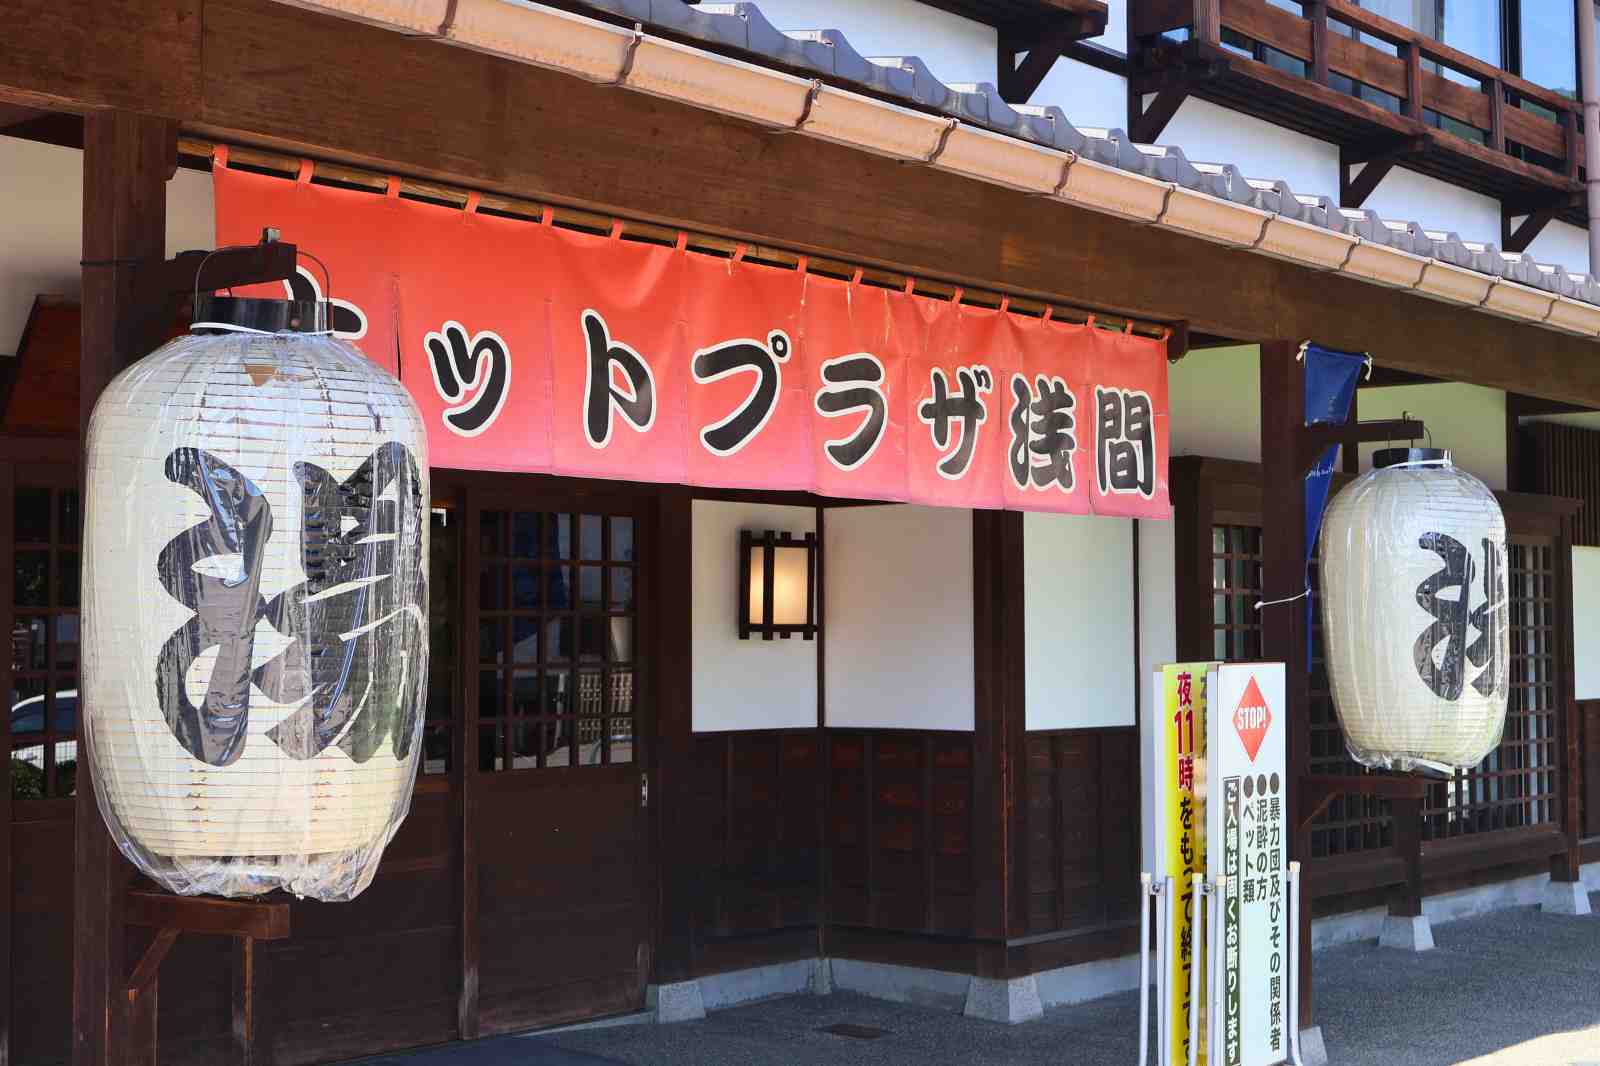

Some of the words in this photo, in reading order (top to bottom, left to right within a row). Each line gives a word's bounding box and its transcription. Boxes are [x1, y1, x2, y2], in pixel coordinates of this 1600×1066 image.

[282, 264, 1157, 501] ットプラザ浅間
[1237, 705, 1267, 731] STOP!
[1226, 781, 1240, 1063] ご入場は固くお断りします
[1243, 799, 1255, 904] ペット類
[1256, 798, 1268, 902] 泥酔の方
[1269, 797, 1281, 1052] 暴力団及びその関係者
